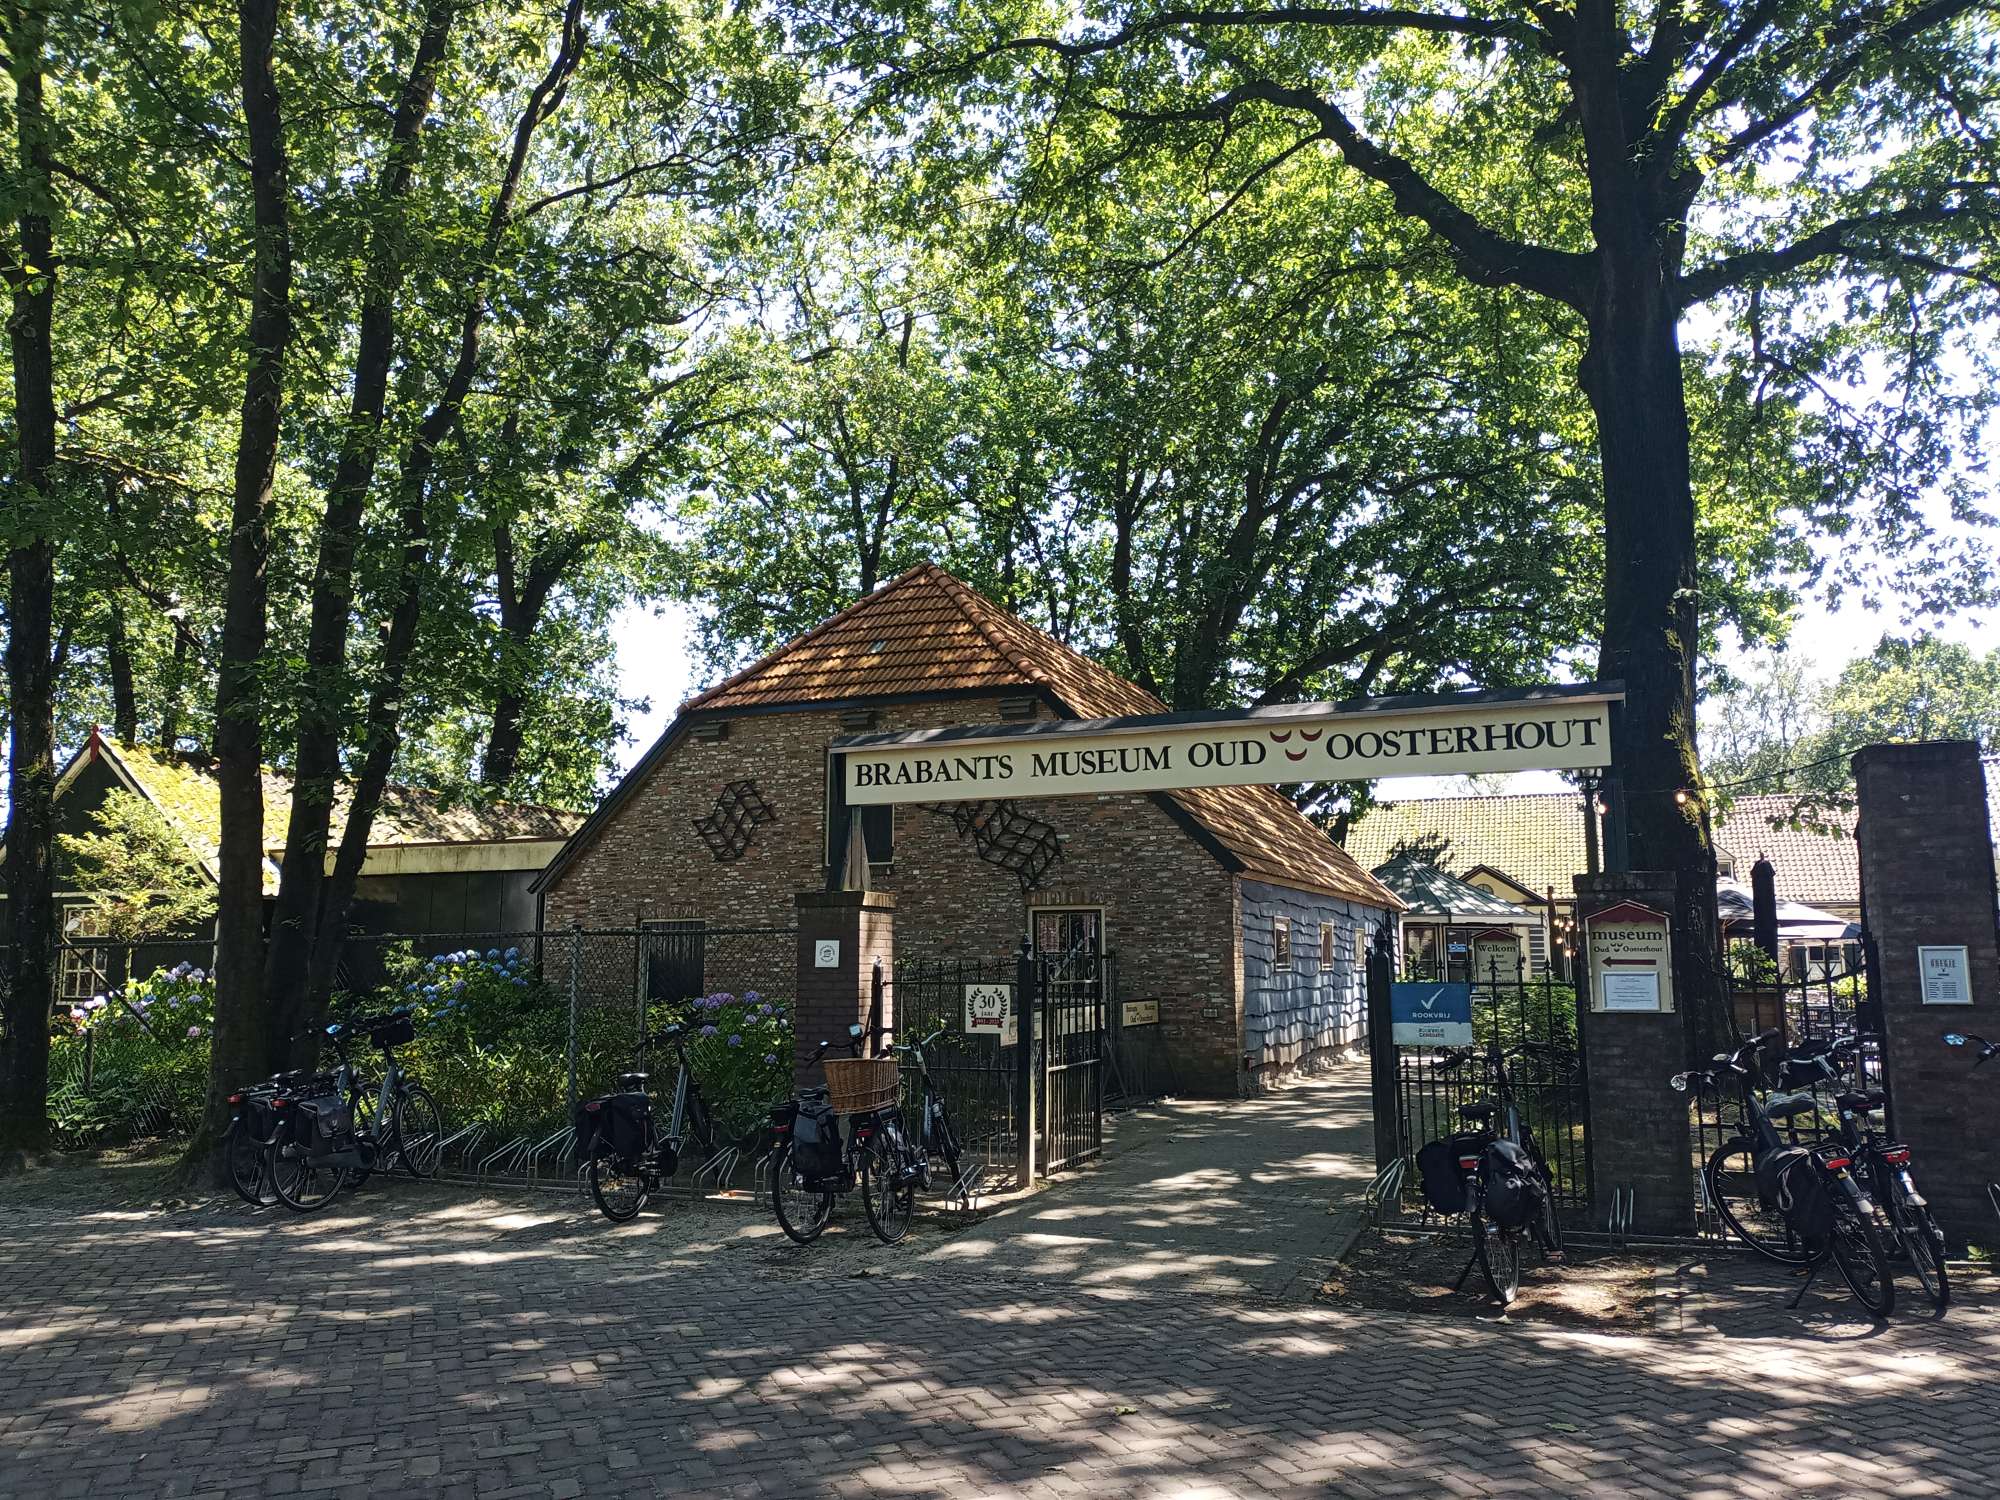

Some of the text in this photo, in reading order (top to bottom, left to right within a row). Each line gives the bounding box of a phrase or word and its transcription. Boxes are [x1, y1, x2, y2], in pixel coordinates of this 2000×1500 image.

[855, 717, 1602, 787] BRABANTS MUSEUM OUD OOSTERHOUT
[1592, 931, 1662, 941] museum
[1478, 944, 1516, 953] Welkom
[979, 994, 995, 1009] 30
[981, 1009, 994, 1017] jaar
